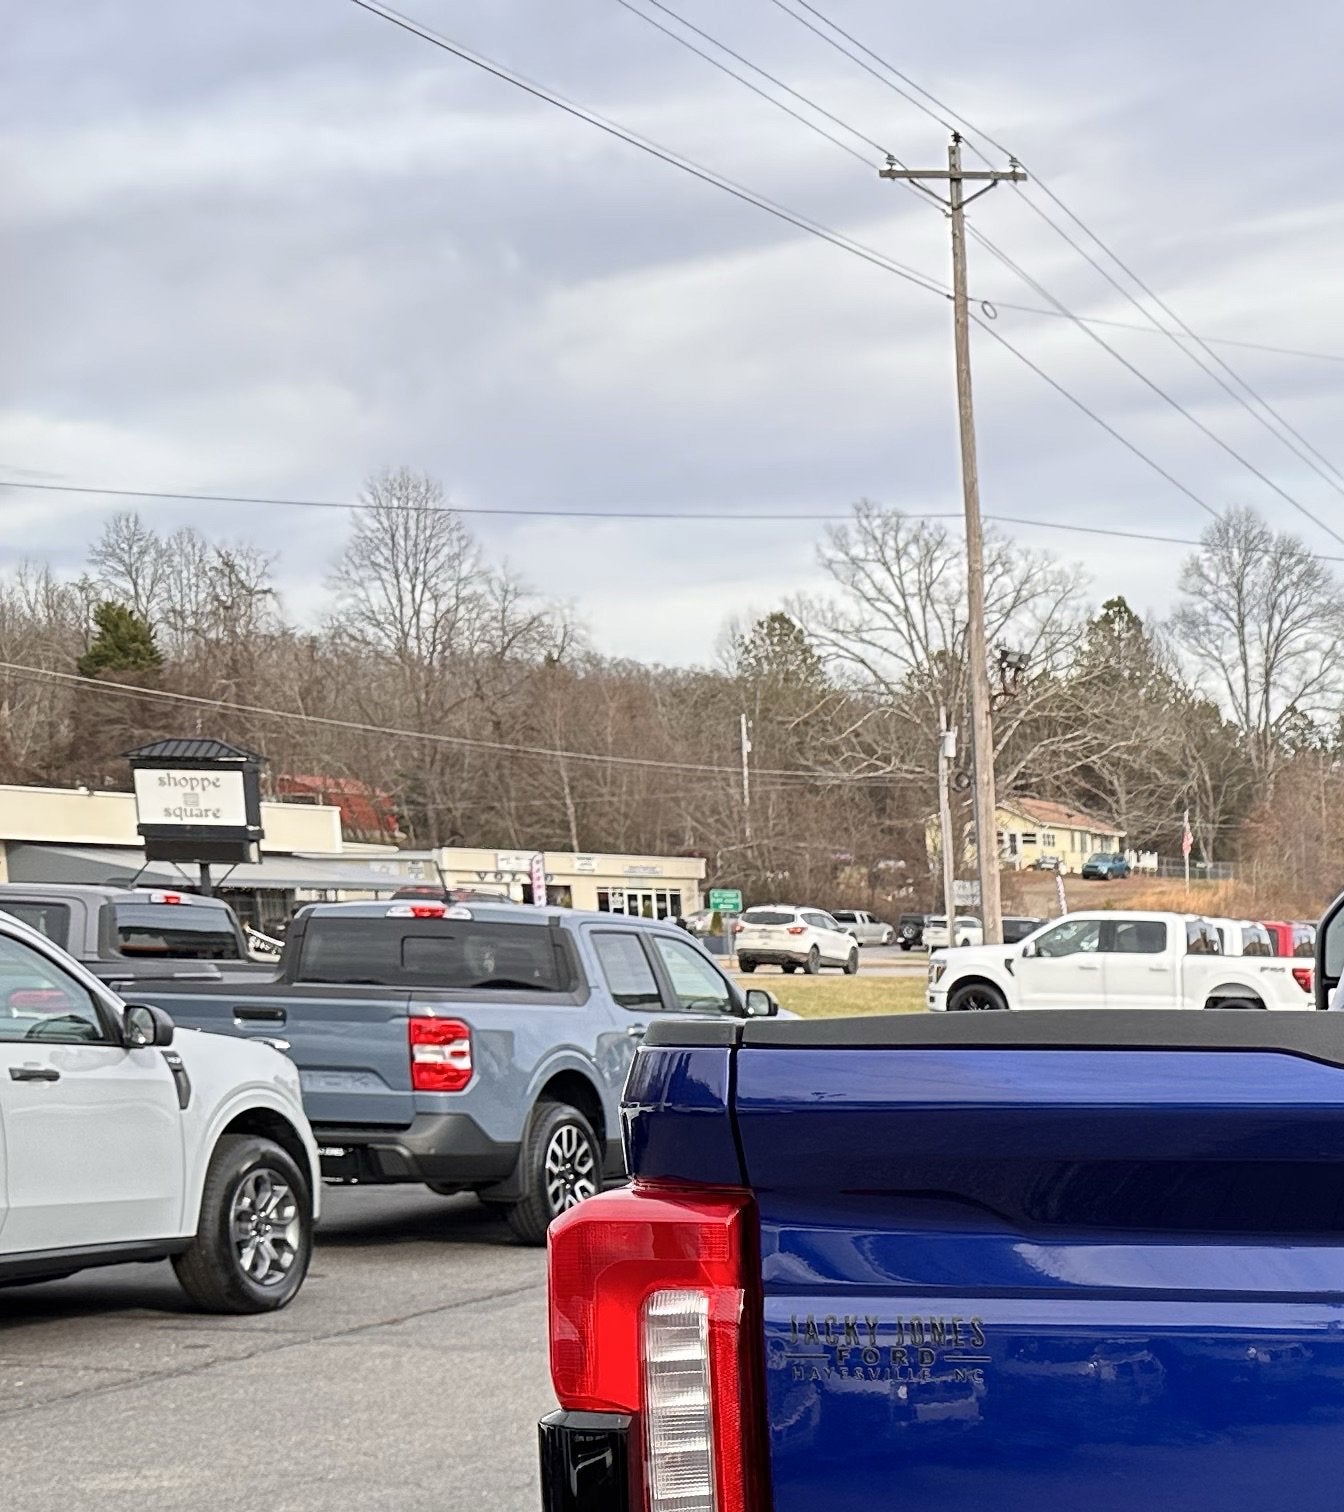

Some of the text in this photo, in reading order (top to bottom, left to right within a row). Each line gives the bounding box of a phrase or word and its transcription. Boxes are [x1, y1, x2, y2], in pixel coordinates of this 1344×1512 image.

[158, 773, 221, 791] shoppe
[163, 806, 221, 821] square
[790, 1314, 986, 1347] JACKY JONES
[837, 1348, 936, 1366] FORD
[955, 1368, 985, 1384] NC
